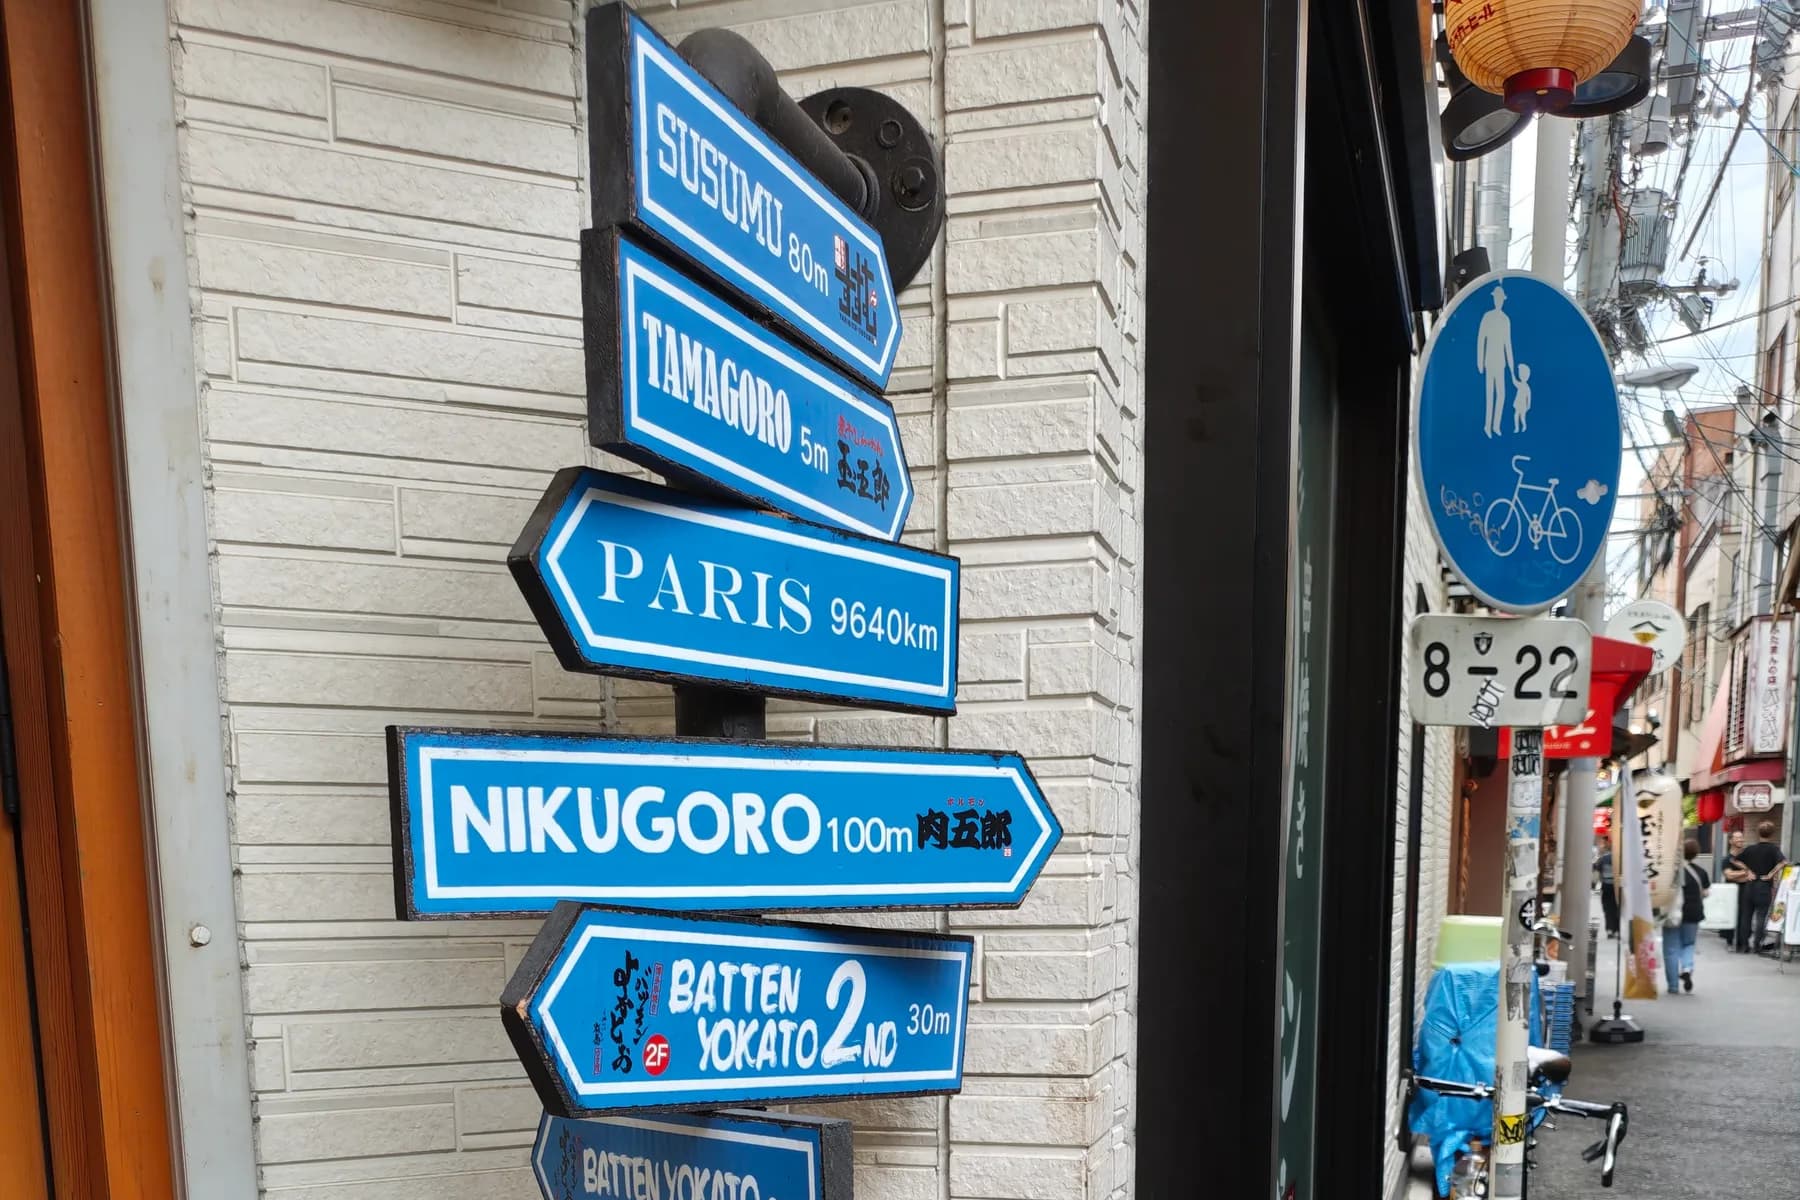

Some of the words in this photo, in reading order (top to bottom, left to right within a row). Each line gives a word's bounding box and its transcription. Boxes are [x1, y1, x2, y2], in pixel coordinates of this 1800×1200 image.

[657, 101, 784, 258] SUSUMU
[788, 231, 829, 297] 80m
[642, 311, 792, 455] TAMAGORO
[801, 425, 828, 475] 5m
[837, 439, 890, 512] 玉五郎
[596, 539, 812, 635] PARIS
[831, 597, 939, 652] 9640km
[450, 783, 822, 855] NIKUGORO
[826, 816, 913, 853] 100m
[916, 808, 1012, 850] 肉五郎
[667, 958, 802, 1016] BATTEN
[696, 1017, 819, 1072] YOKATO
[906, 1003, 951, 1037] 30m
[645, 1043, 669, 1067] 2F
